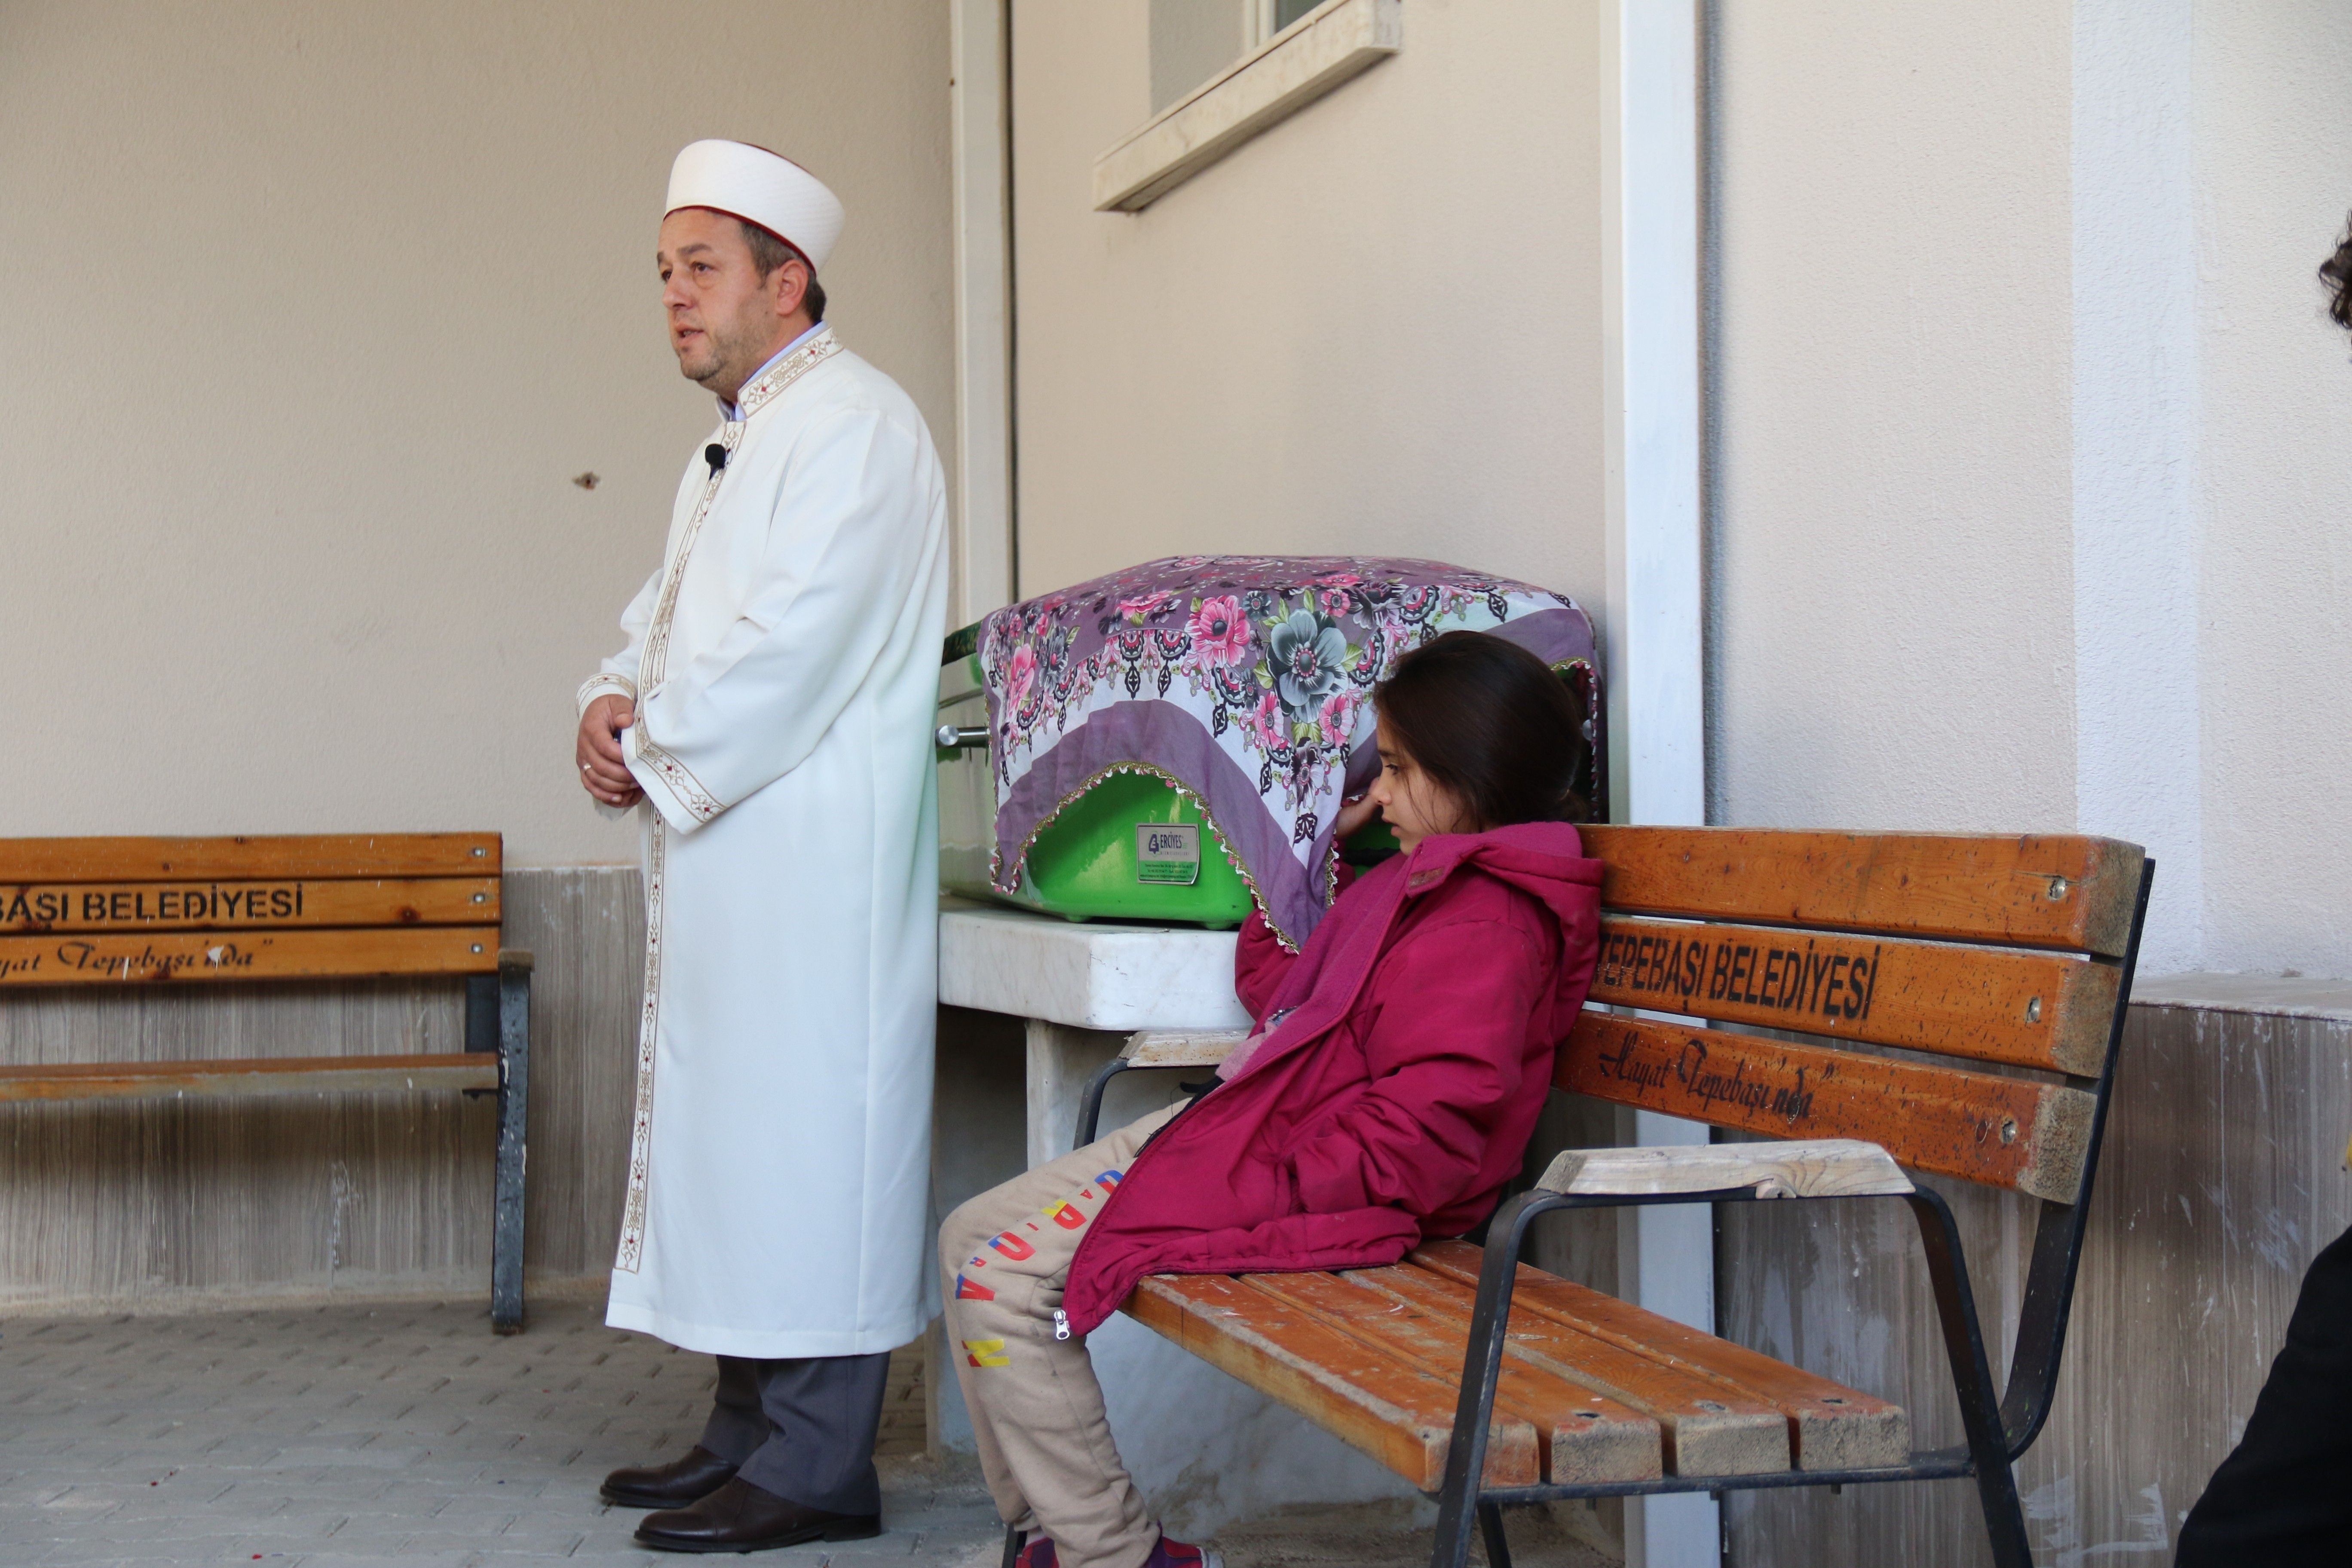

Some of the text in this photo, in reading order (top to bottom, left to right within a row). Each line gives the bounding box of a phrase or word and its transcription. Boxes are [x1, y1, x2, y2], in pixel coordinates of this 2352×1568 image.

[1161, 831, 1182, 848] ERCİYES
[0, 883, 302, 931] AŞI BELEDİYESİ
[1594, 933, 1881, 1020] TEPEBAŞI BELEDİYESİ
